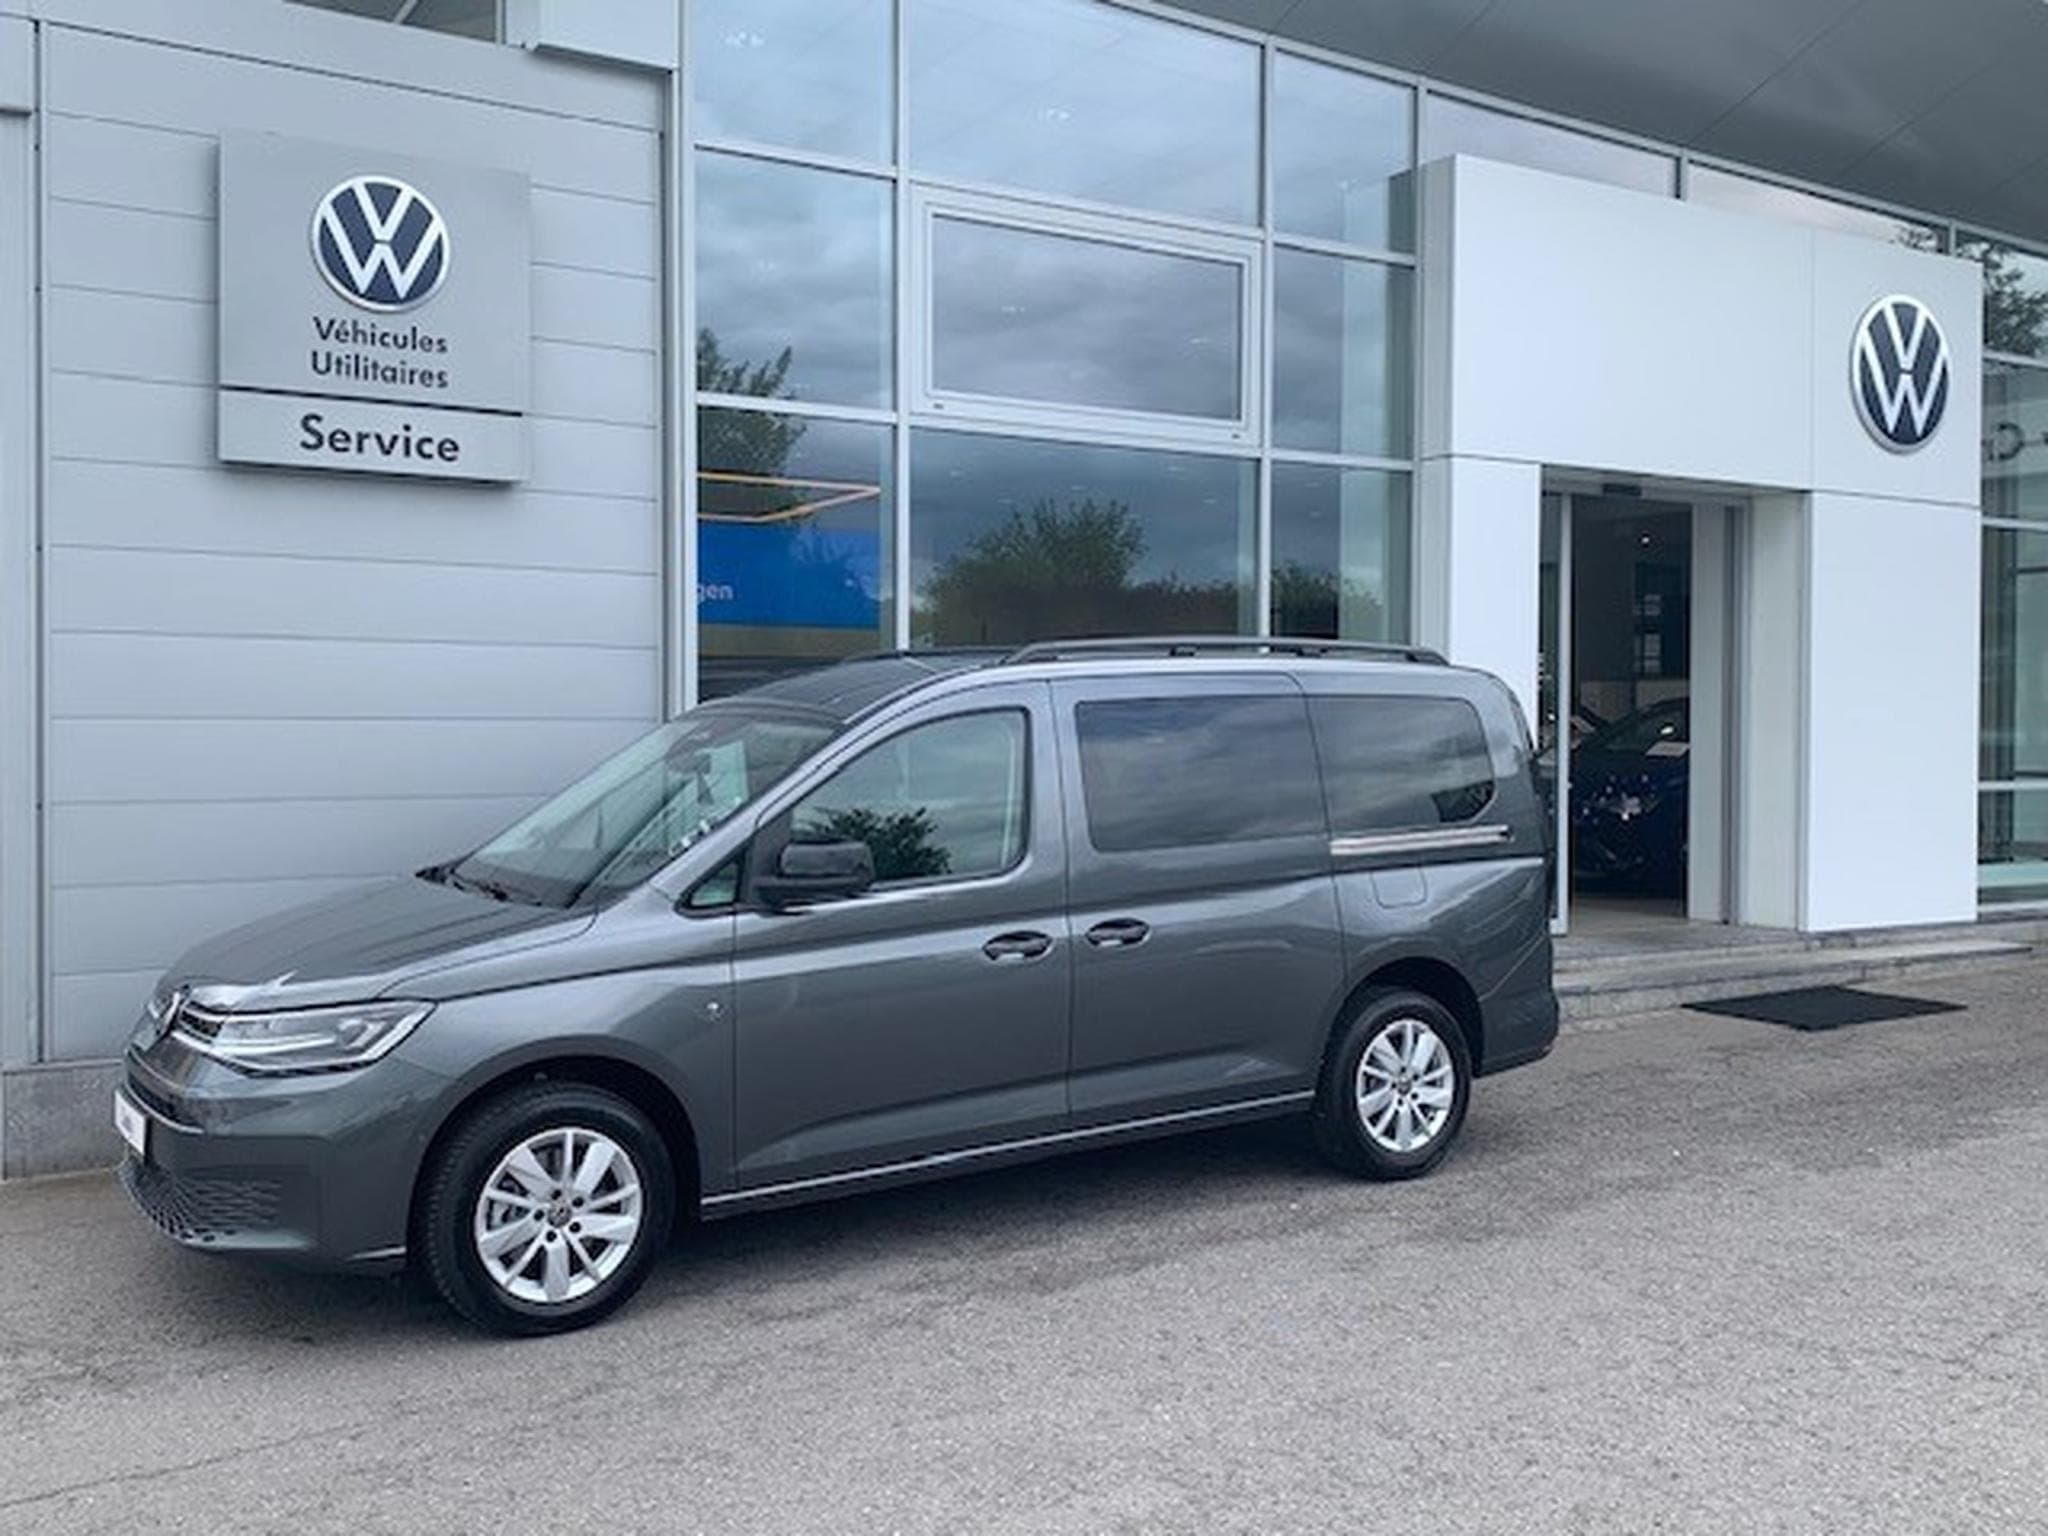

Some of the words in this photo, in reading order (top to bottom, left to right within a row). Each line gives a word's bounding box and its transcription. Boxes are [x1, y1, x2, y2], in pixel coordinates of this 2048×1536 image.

[314, 178, 449, 309] VW
[313, 316, 449, 353] Véhicules
[312, 351, 449, 388] Utilitaires
[1853, 296, 1951, 450] VW
[299, 413, 461, 462] Service
